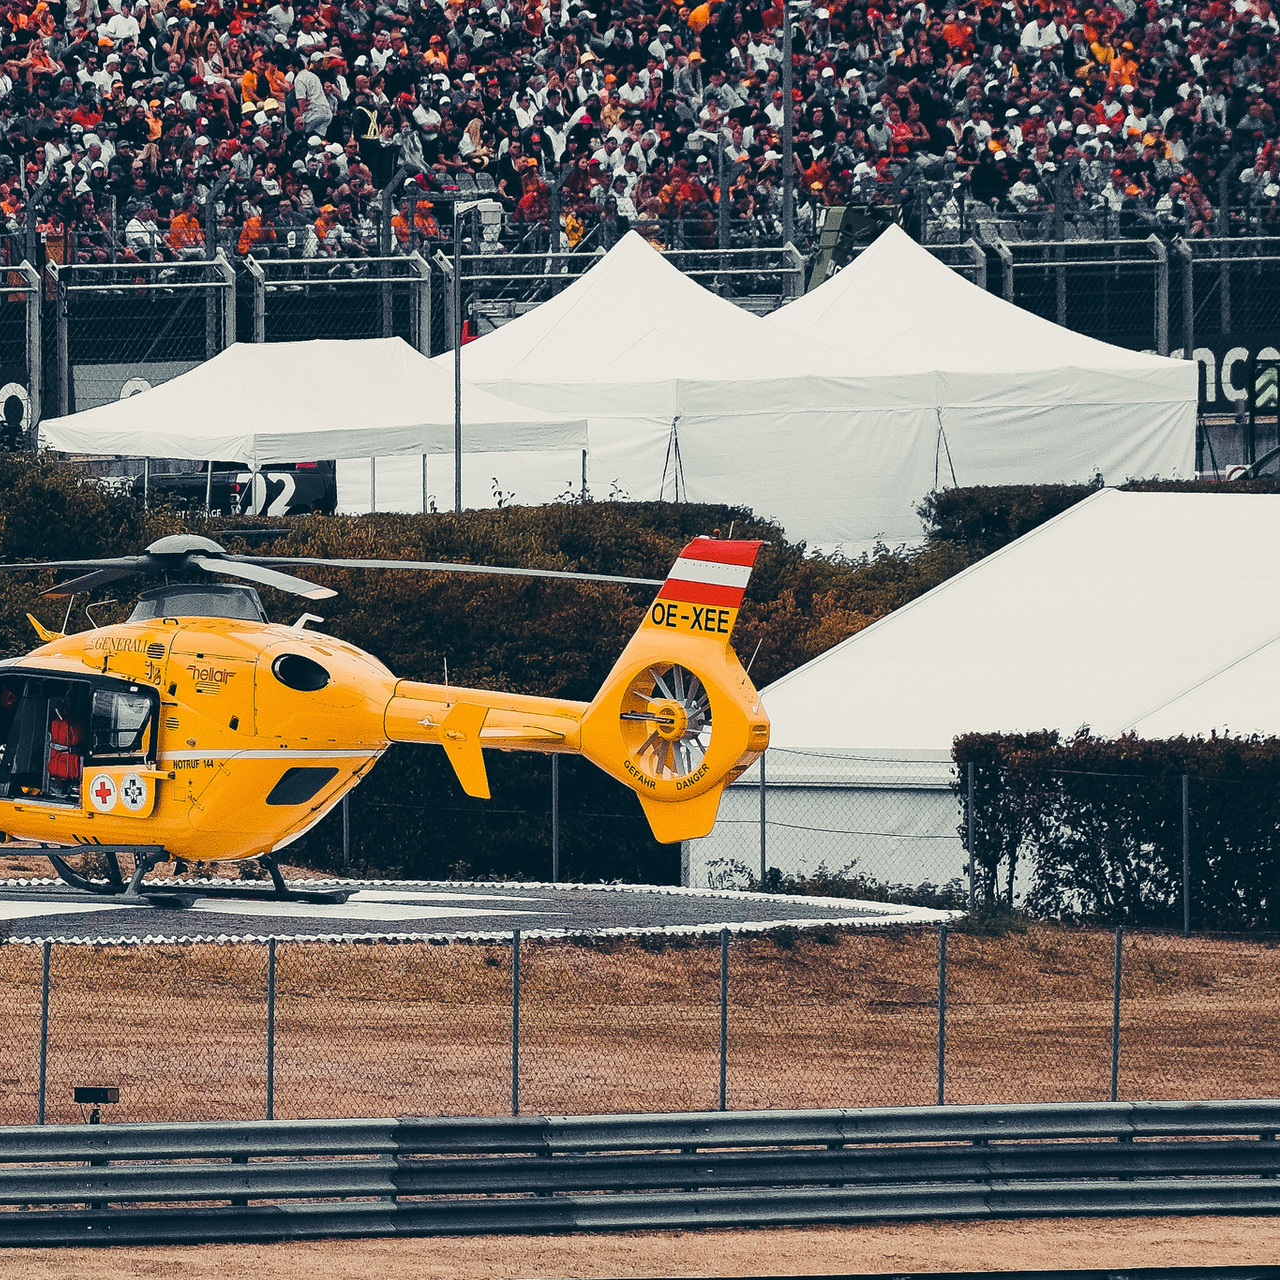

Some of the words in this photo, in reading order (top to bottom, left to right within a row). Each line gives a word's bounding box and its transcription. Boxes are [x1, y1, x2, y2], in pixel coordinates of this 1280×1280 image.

[651, 602, 730, 634] OE-XEE
[95, 637, 148, 653] GENERALI
[186, 665, 237, 685] heliair
[173, 759, 200, 770] NOTRUF
[203, 758, 214, 768] 144
[623, 759, 657, 790] GEFAHR
[676, 763, 710, 791] DANGER
